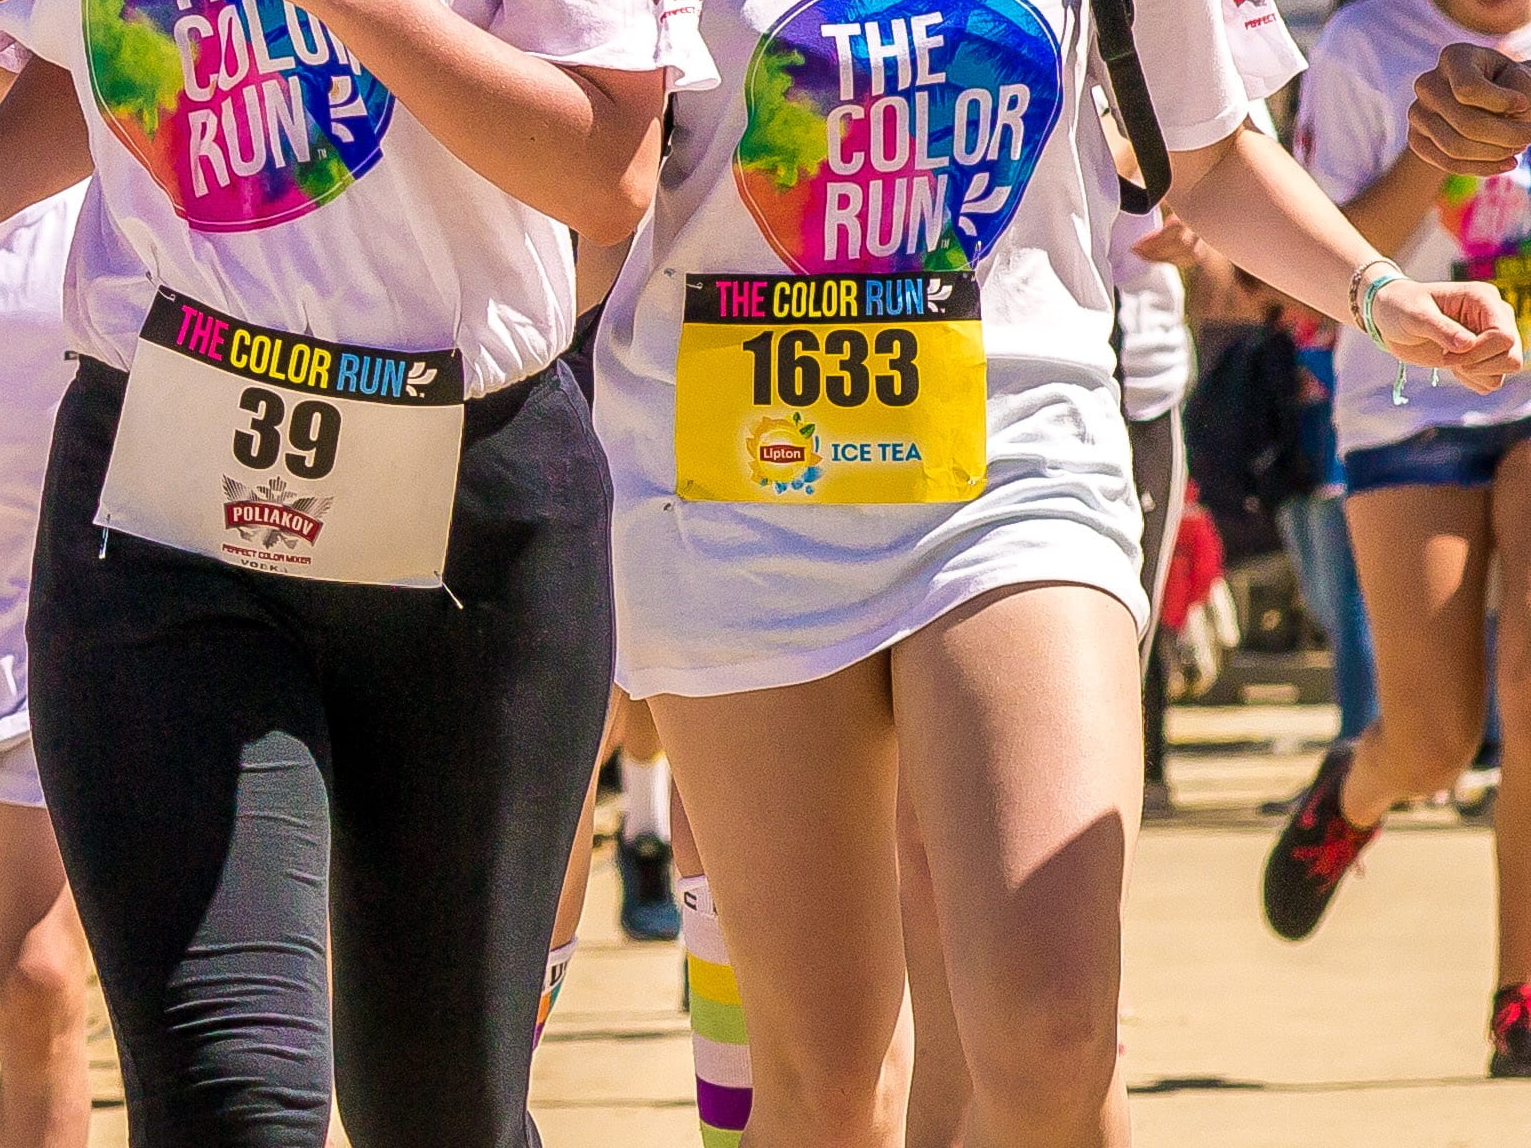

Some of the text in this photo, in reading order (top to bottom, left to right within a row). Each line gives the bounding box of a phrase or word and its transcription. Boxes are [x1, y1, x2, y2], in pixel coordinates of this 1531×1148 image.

[821, 12, 946, 101] THE
[188, 76, 311, 198] RUN
[826, 83, 1031, 175] COLOR
[823, 173, 949, 261] RUN
[715, 278, 924, 318] THE COLOR RUN
[176, 304, 406, 397] THE COLOR RUN
[742, 328, 920, 407] 1633
[233, 387, 342, 480] 39
[763, 447, 802, 460] Lipton
[831, 442, 922, 462] ICE TEA
[222, 544, 312, 565] PERFECT COLOR MIXER
[233, 506, 314, 536] POLIAKOV
